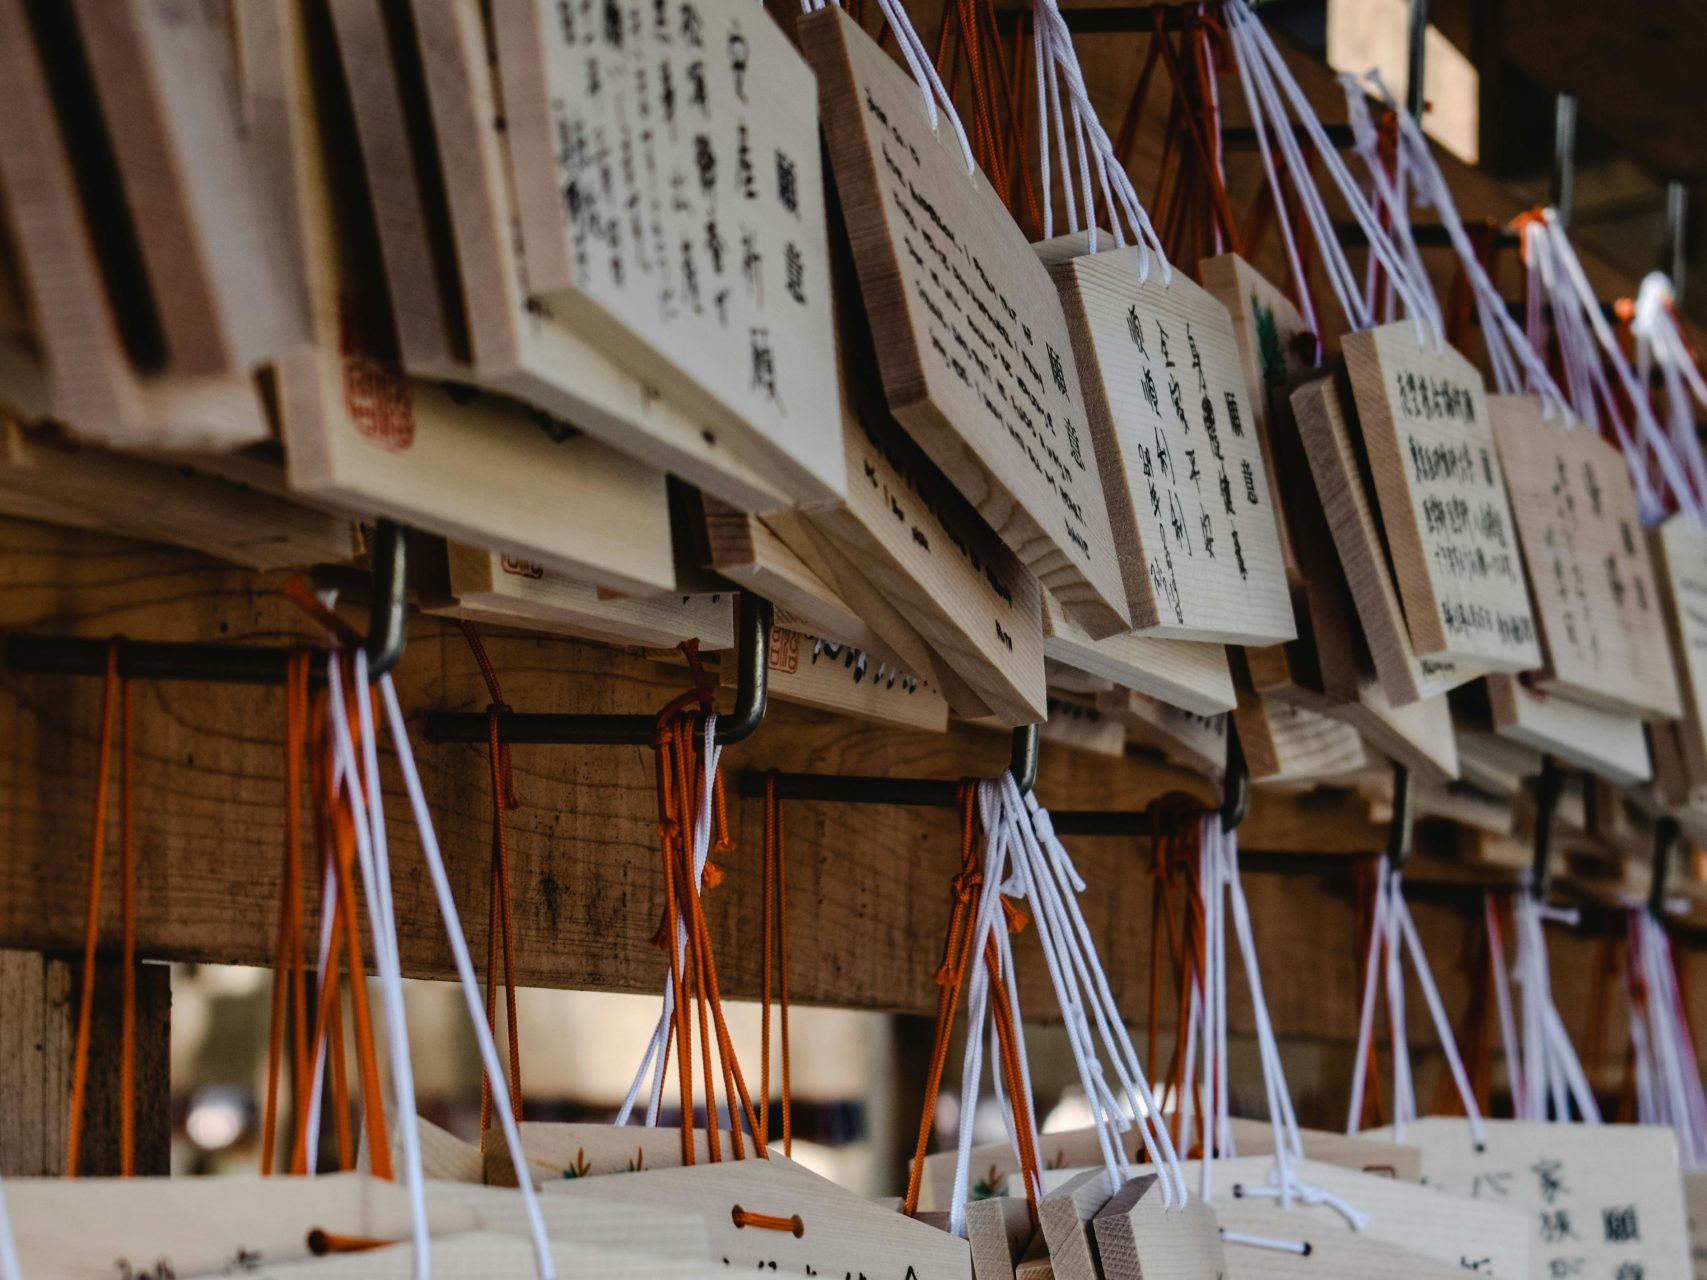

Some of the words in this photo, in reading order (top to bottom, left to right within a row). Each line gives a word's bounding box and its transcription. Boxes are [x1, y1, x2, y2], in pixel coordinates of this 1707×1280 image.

[1045, 340, 1086, 471] 願意
[1126, 303, 1192, 557] 順順利利
[1156, 318, 1216, 559] 全家平安
[1224, 390, 1259, 506] 願意
